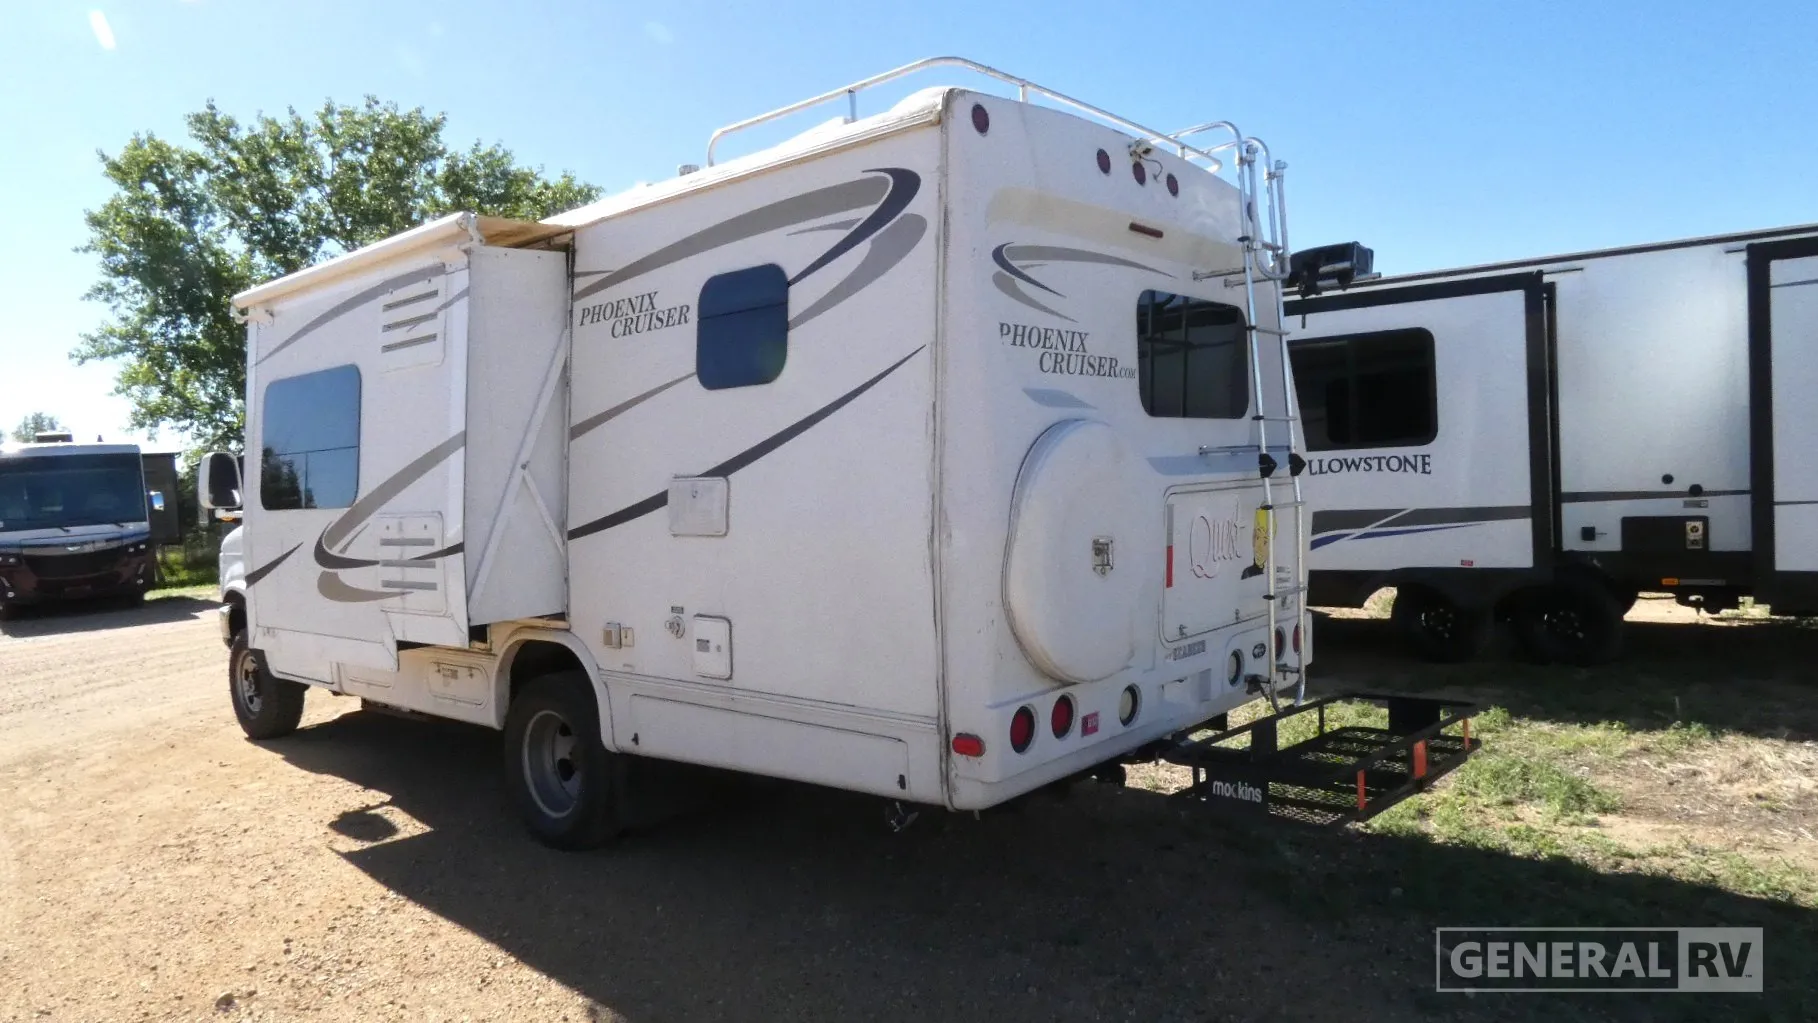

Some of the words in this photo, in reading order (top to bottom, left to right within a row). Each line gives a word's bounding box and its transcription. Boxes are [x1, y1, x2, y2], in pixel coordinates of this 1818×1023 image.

[580, 291, 659, 327] PHOENIX
[611, 304, 691, 338] CRUISER
[999, 322, 1090, 352] PHOENIX
[1308, 454, 1432, 476] LLOWSTONE
[1212, 780, 1263, 803] mockins
